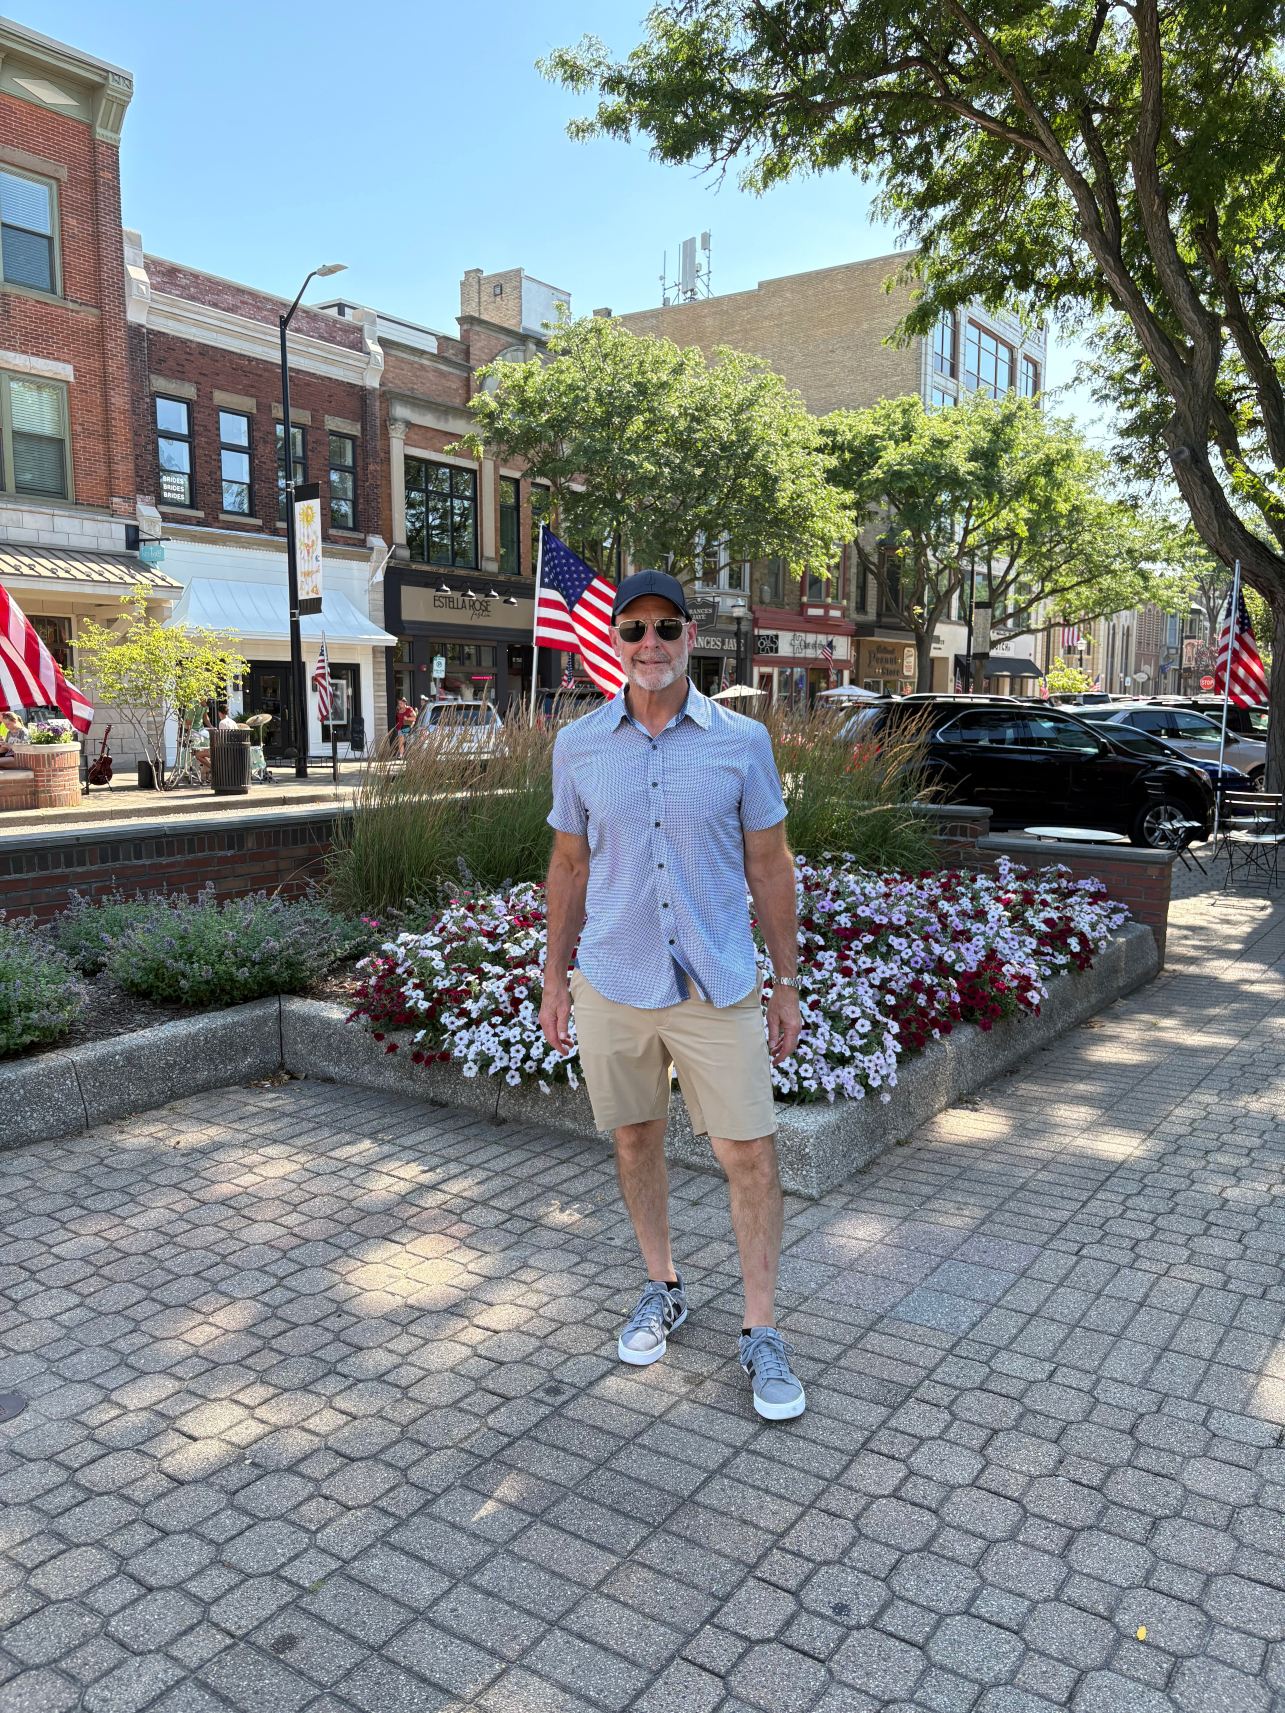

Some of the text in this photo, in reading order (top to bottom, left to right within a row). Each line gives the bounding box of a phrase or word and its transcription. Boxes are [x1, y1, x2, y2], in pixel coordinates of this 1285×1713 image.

[163, 475, 184, 484] BRIDES
[163, 484, 185, 492] BRIDES
[163, 492, 185, 500] BRIDES
[433, 595, 491, 612] ESTELLA ROSE
[694, 636, 722, 650] ANCES
